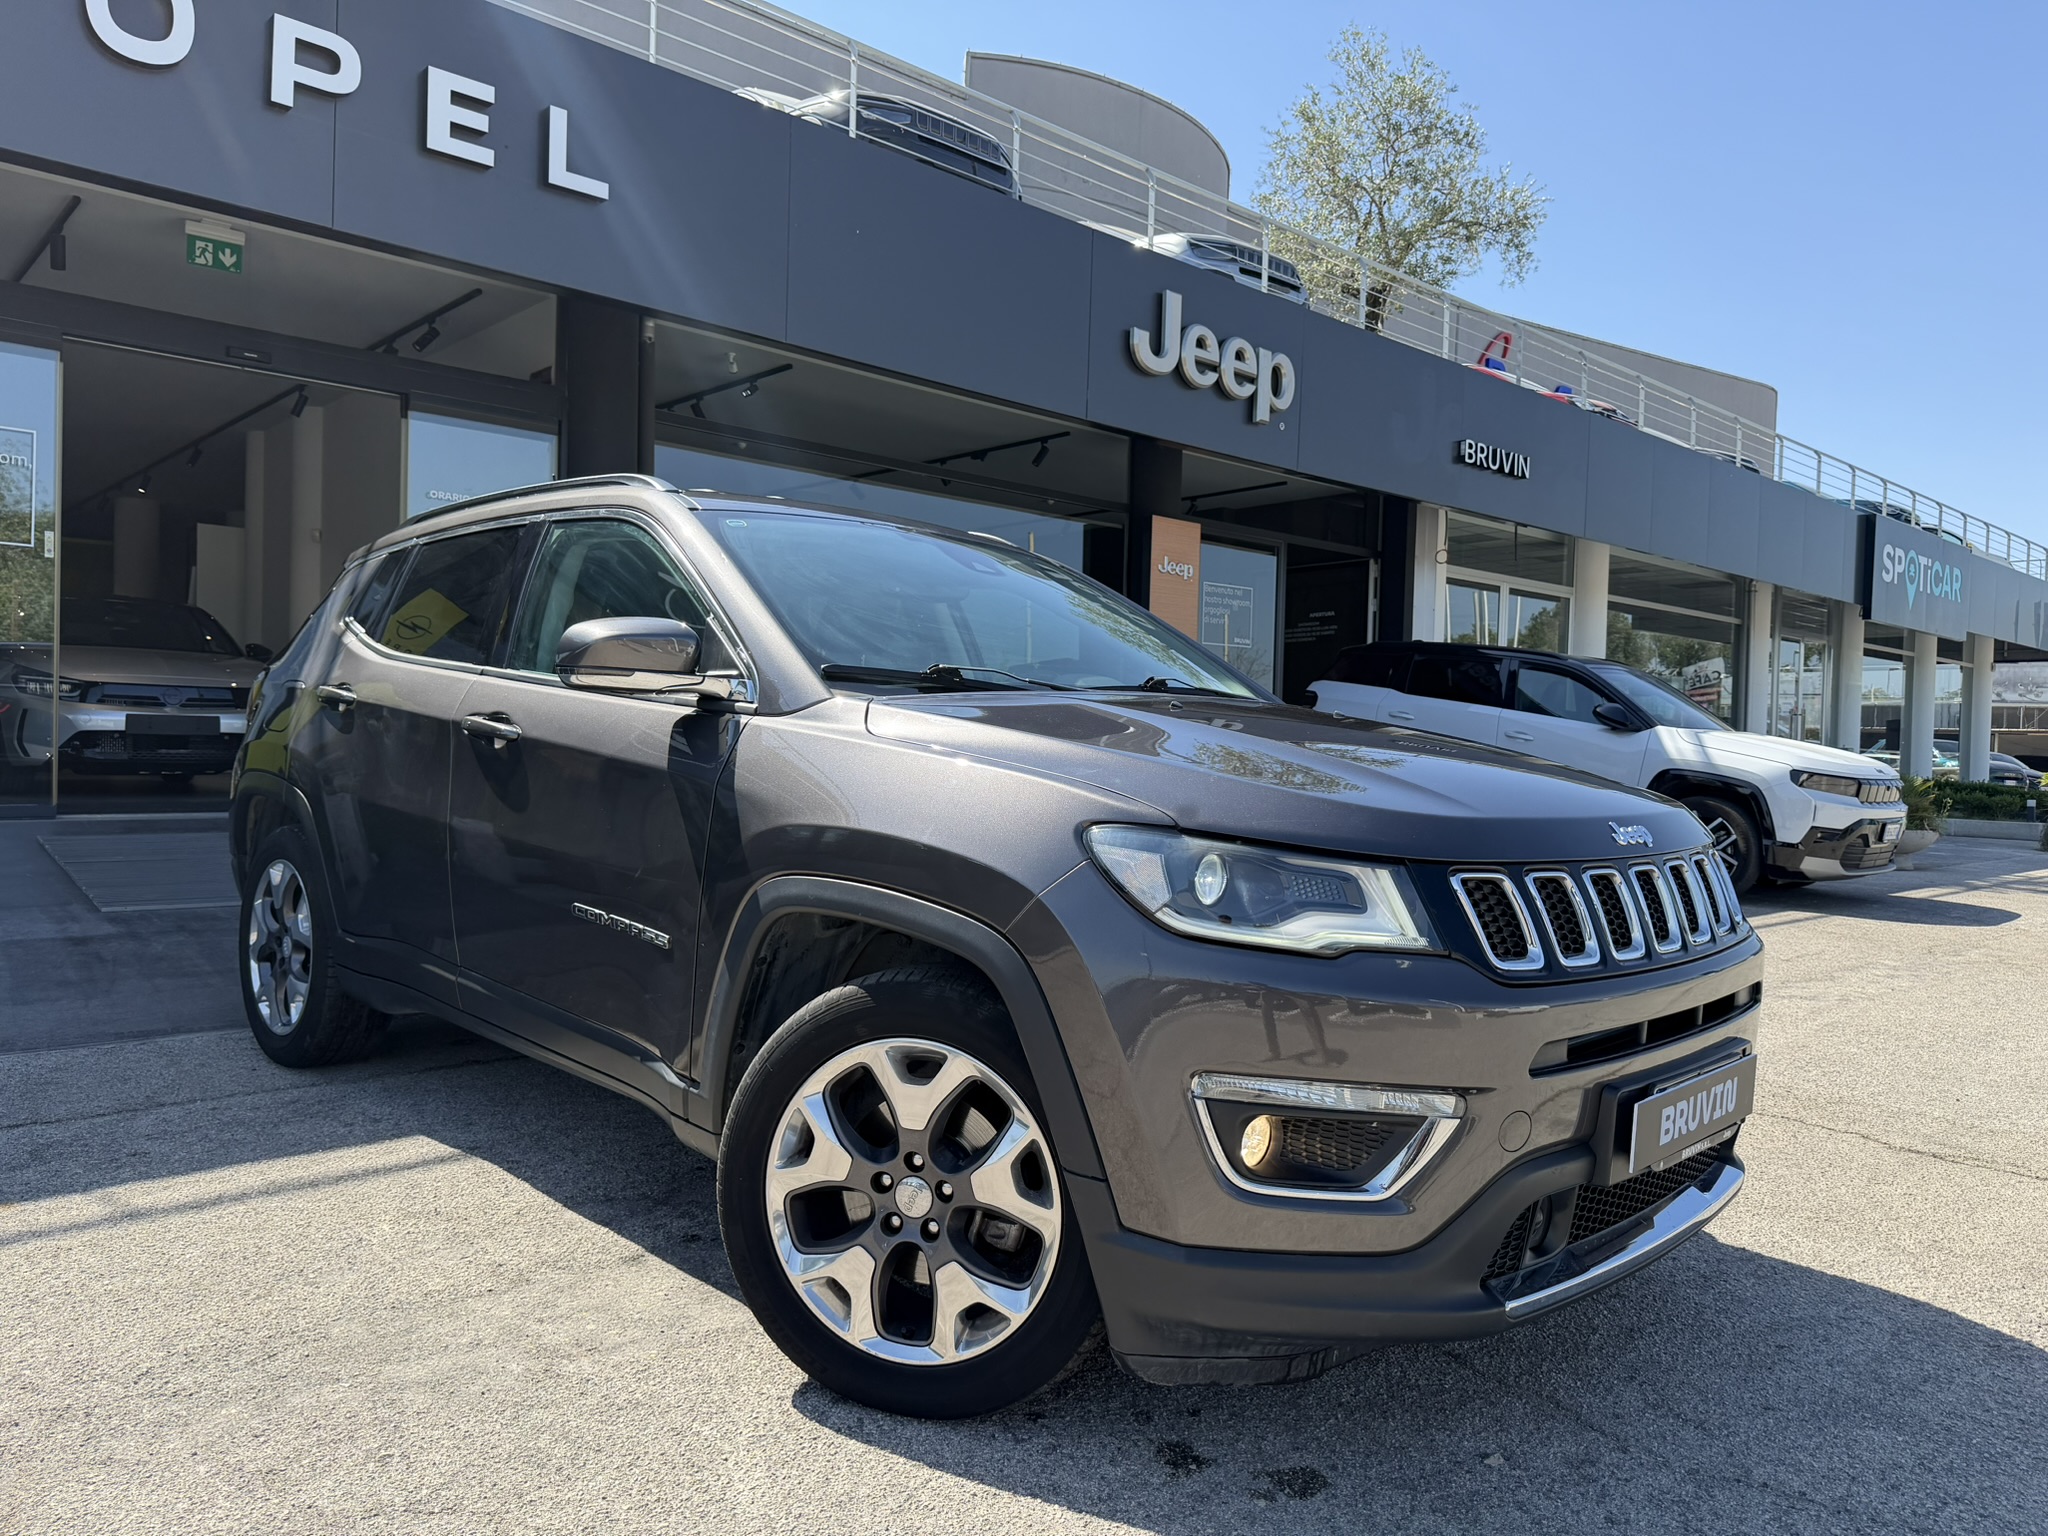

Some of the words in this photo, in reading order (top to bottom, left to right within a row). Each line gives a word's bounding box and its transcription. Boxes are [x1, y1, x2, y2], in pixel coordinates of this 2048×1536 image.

[87, 0, 609, 200] OPEL
[1130, 289, 1295, 424] Jeep
[1465, 439, 1530, 479] BRUVIN
[1158, 555, 1194, 580] Jeep
[1608, 821, 1653, 848] Jeep
[1659, 1076, 1738, 1146] BRUVIN
